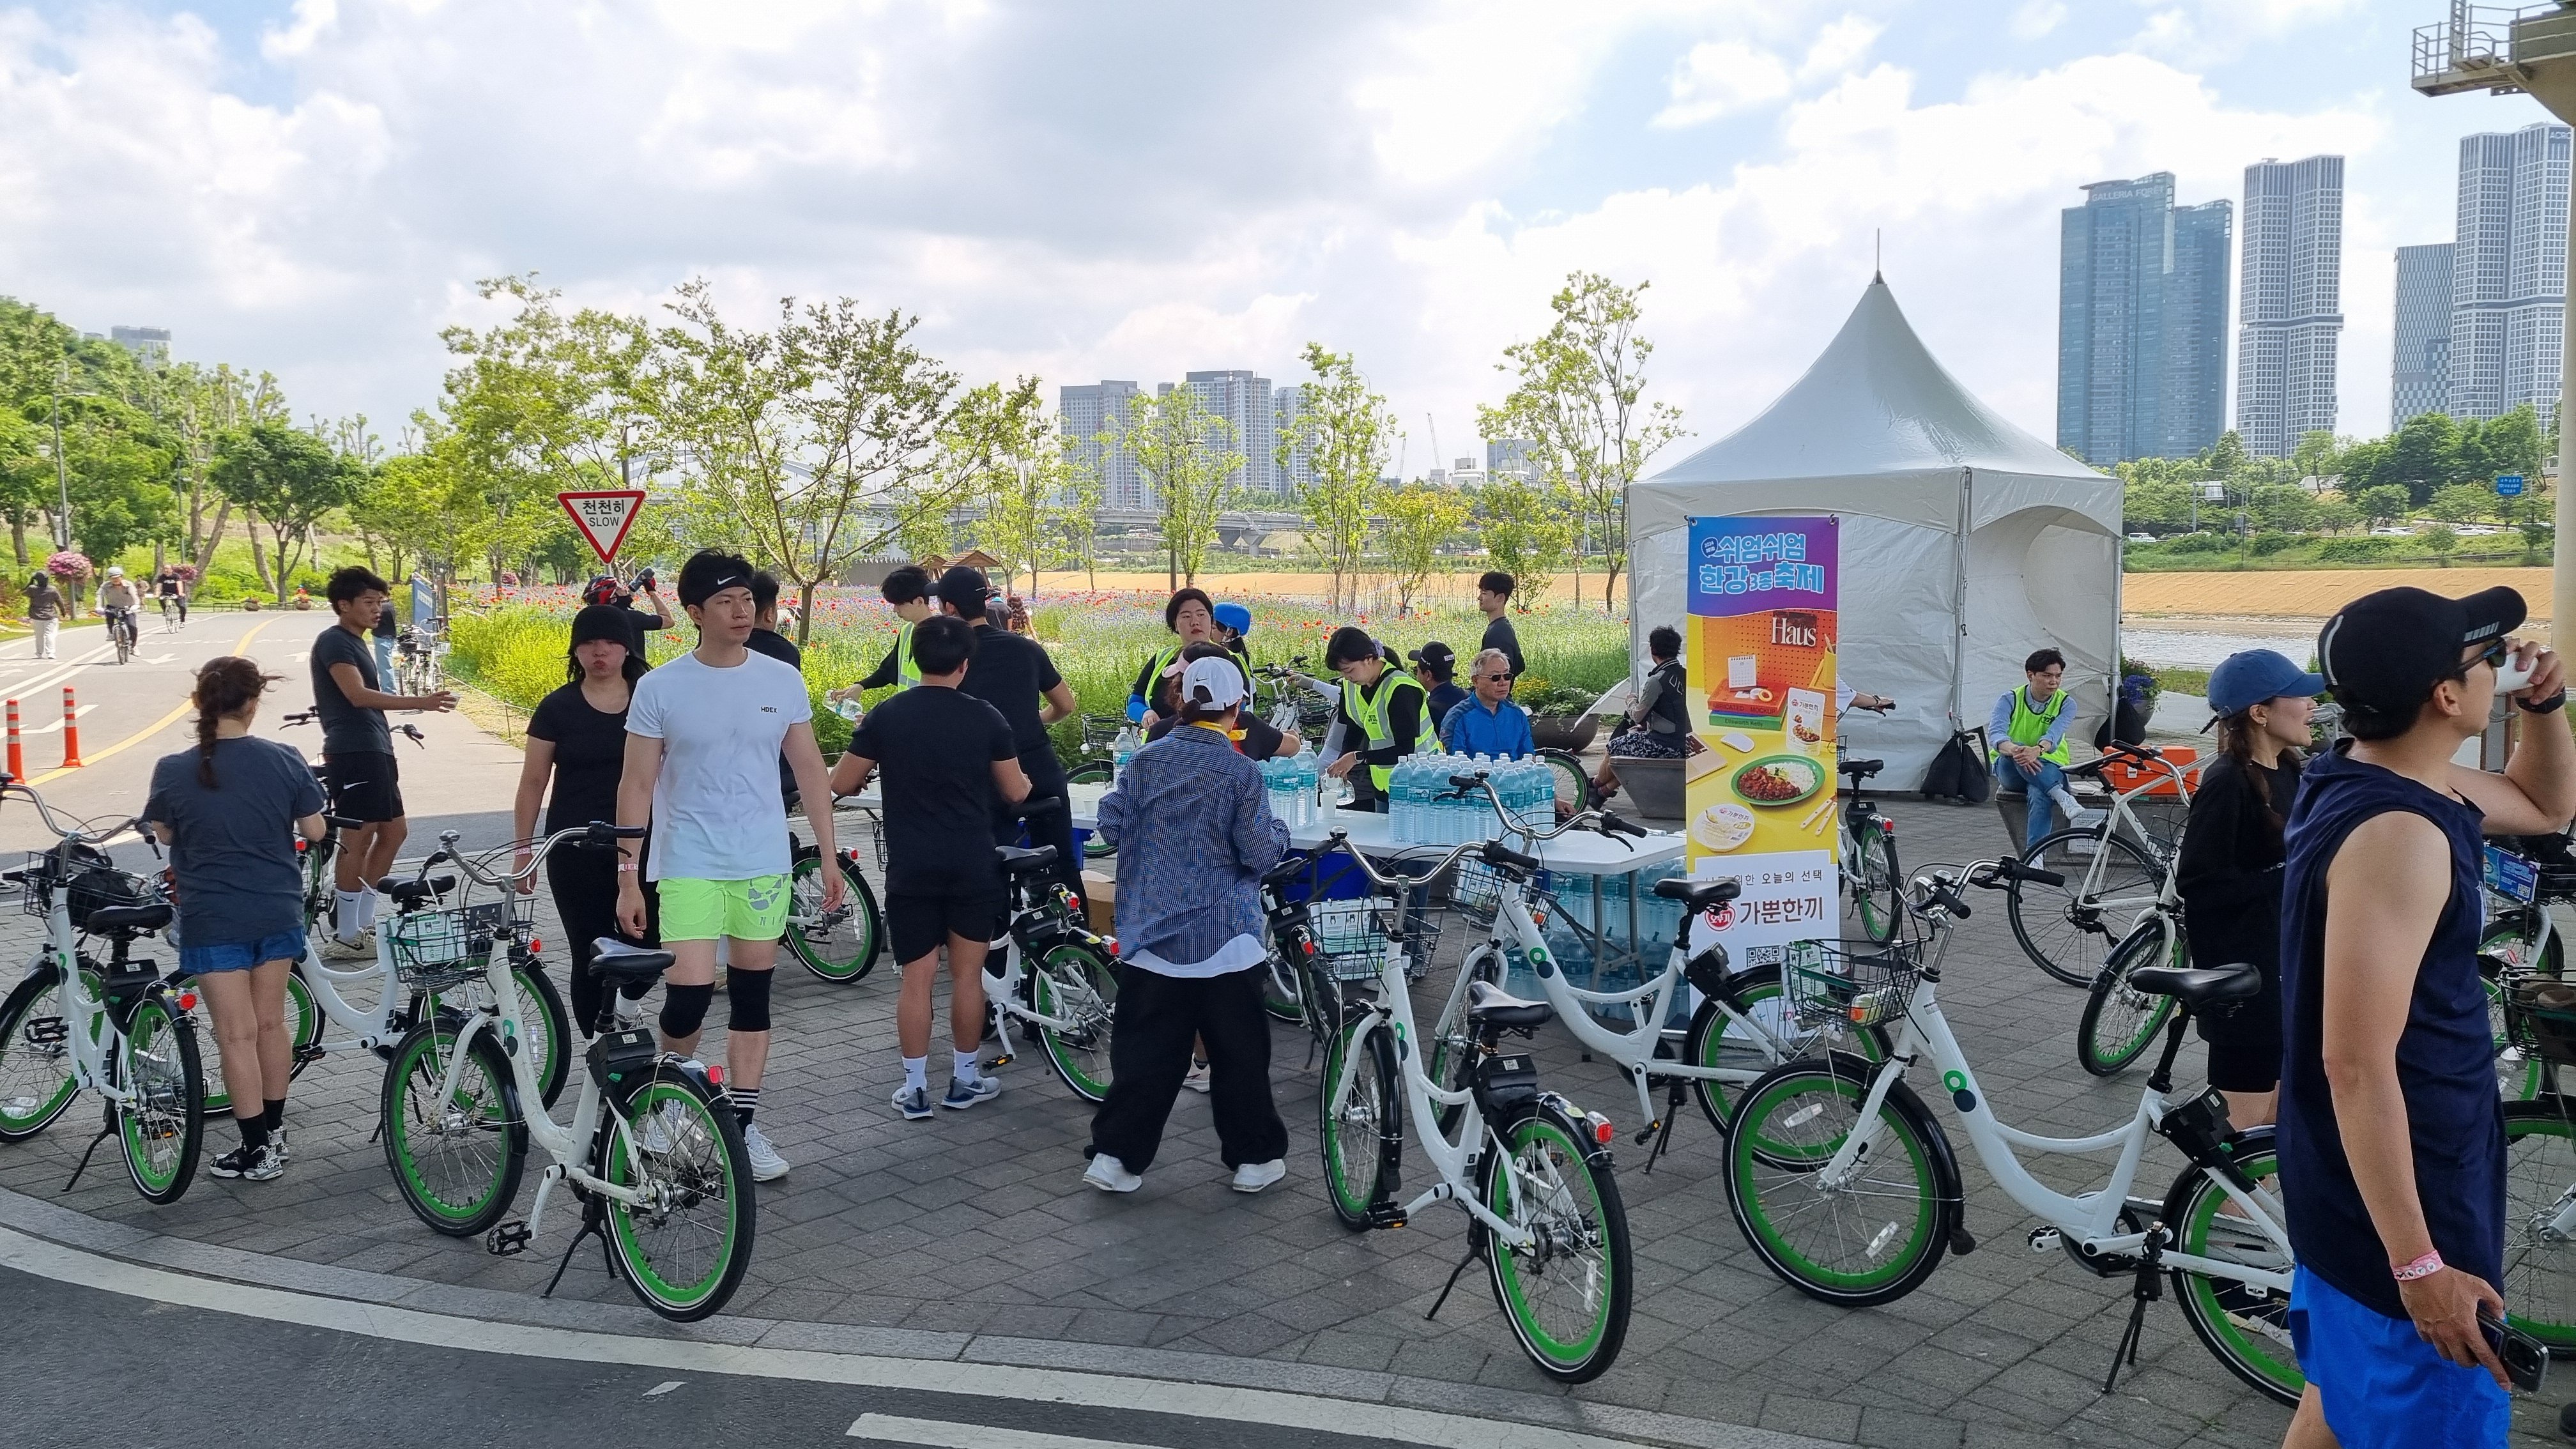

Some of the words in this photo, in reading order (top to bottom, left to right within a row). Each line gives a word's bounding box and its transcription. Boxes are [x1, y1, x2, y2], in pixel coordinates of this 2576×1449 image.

[2092, 190, 2133, 202] GALLERIA
[583, 499, 625, 515] 천천히
[589, 517, 619, 526] SLOW
[1718, 533, 1806, 564] 쉬엄쉬엄
[1699, 564, 1750, 594] 한강
[1749, 571, 1774, 591] 3종
[1774, 561, 1825, 594] 축제
[1772, 617, 1816, 647] Haus
[1733, 873, 1755, 886] 위한
[1761, 871, 1795, 884] 오늘의
[1801, 870, 1822, 882] 선택
[1740, 896, 1823, 924] 가뿐한끼
